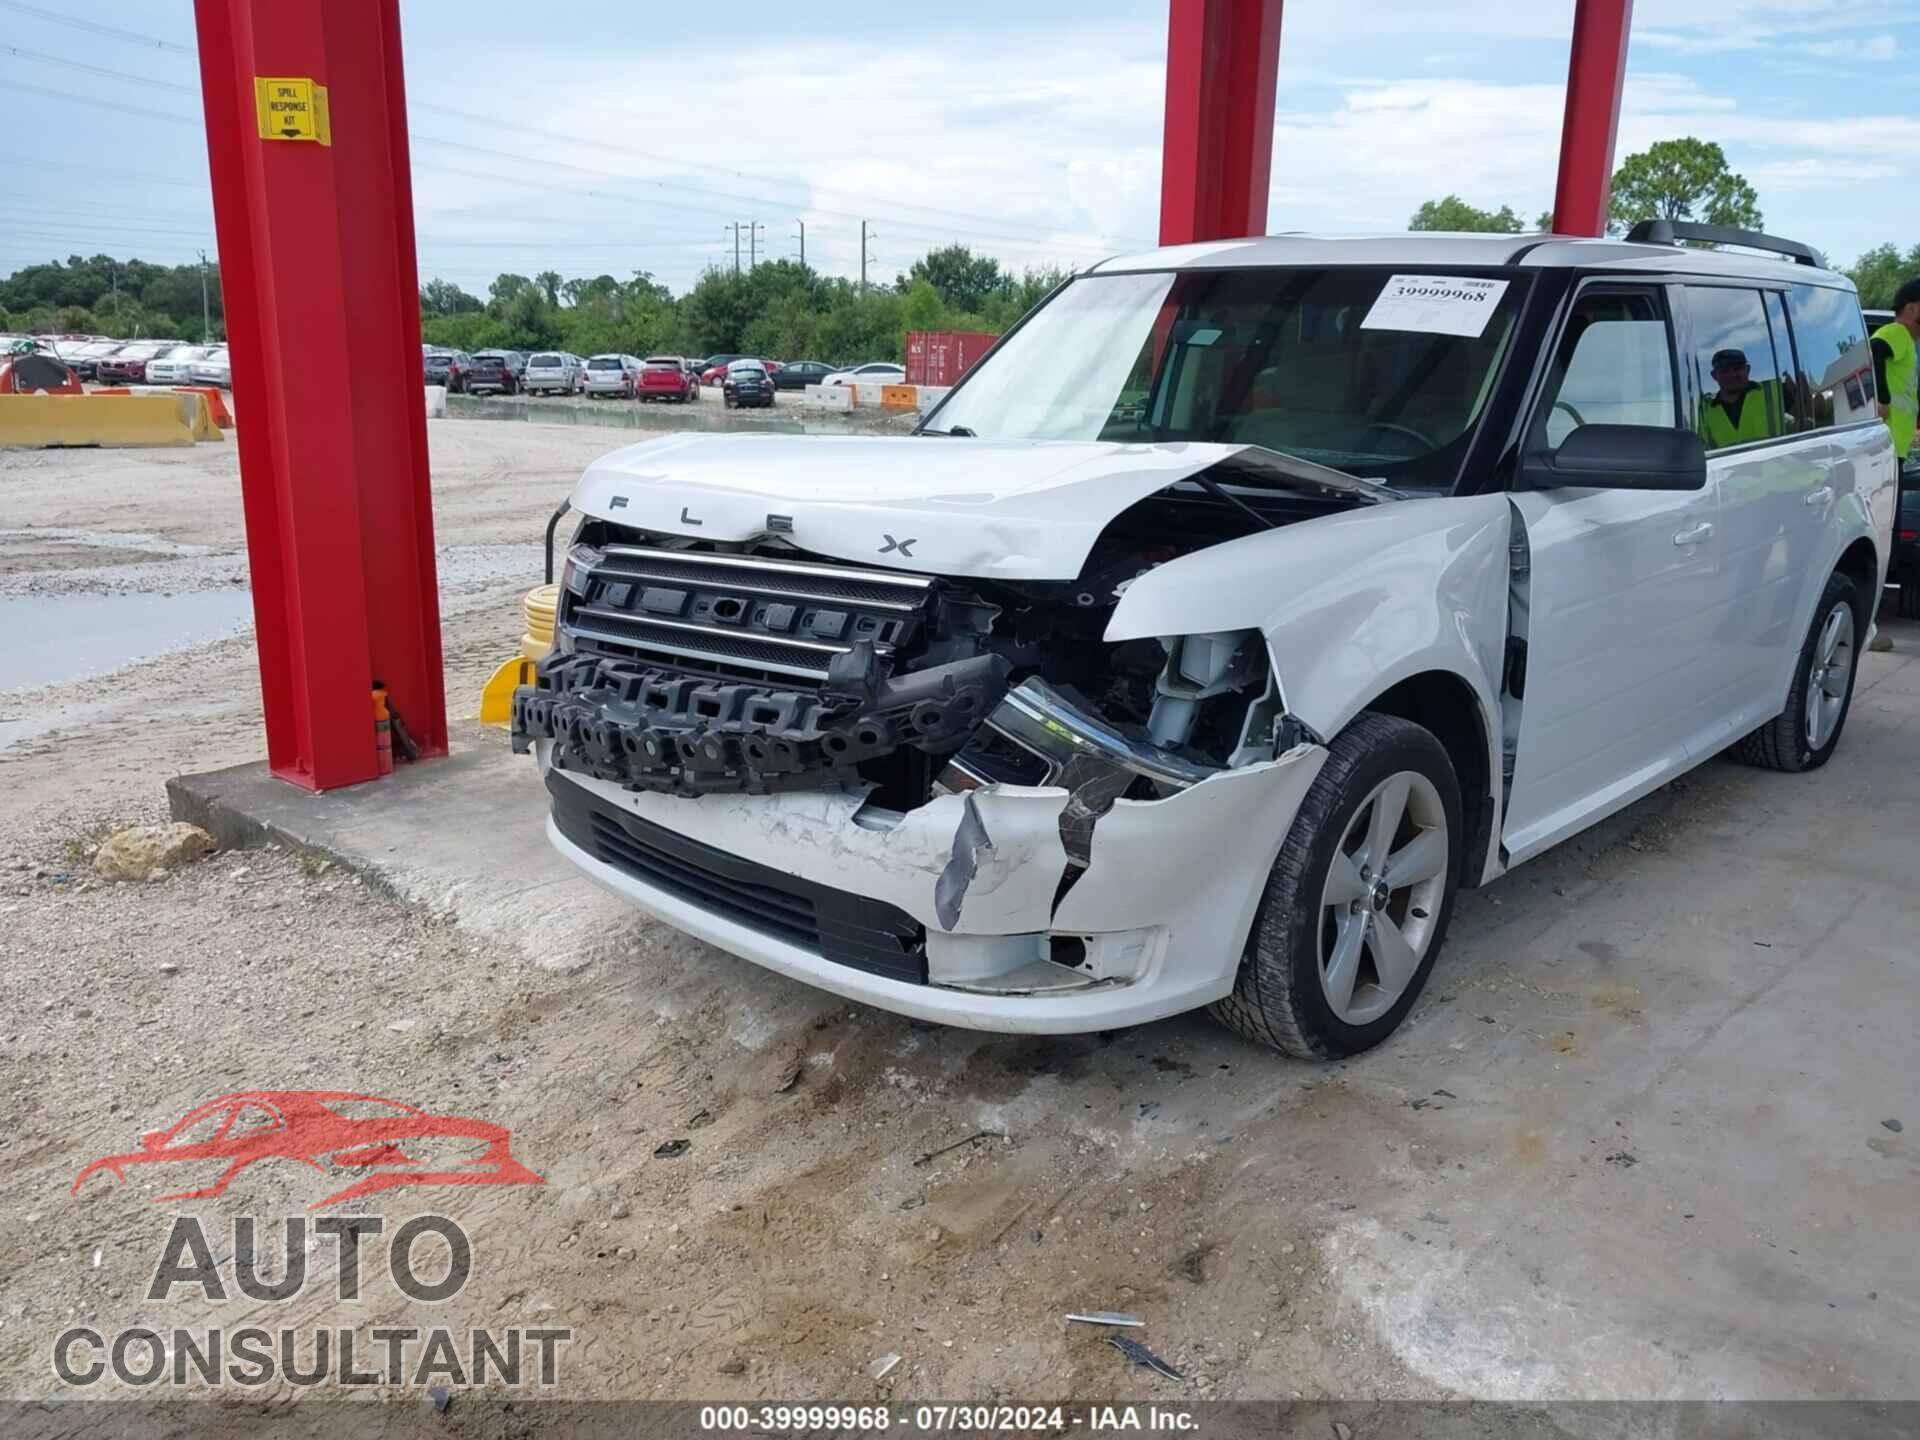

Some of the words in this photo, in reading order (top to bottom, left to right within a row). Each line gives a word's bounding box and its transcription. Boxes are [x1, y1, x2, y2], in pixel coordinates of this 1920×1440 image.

[278, 88, 297, 98] SPILL
[271, 102, 307, 111] RESPONSE
[284, 115, 295, 125] KIT
[1391, 286, 1488, 302] 39999968
[609, 495, 918, 557] FLEX
